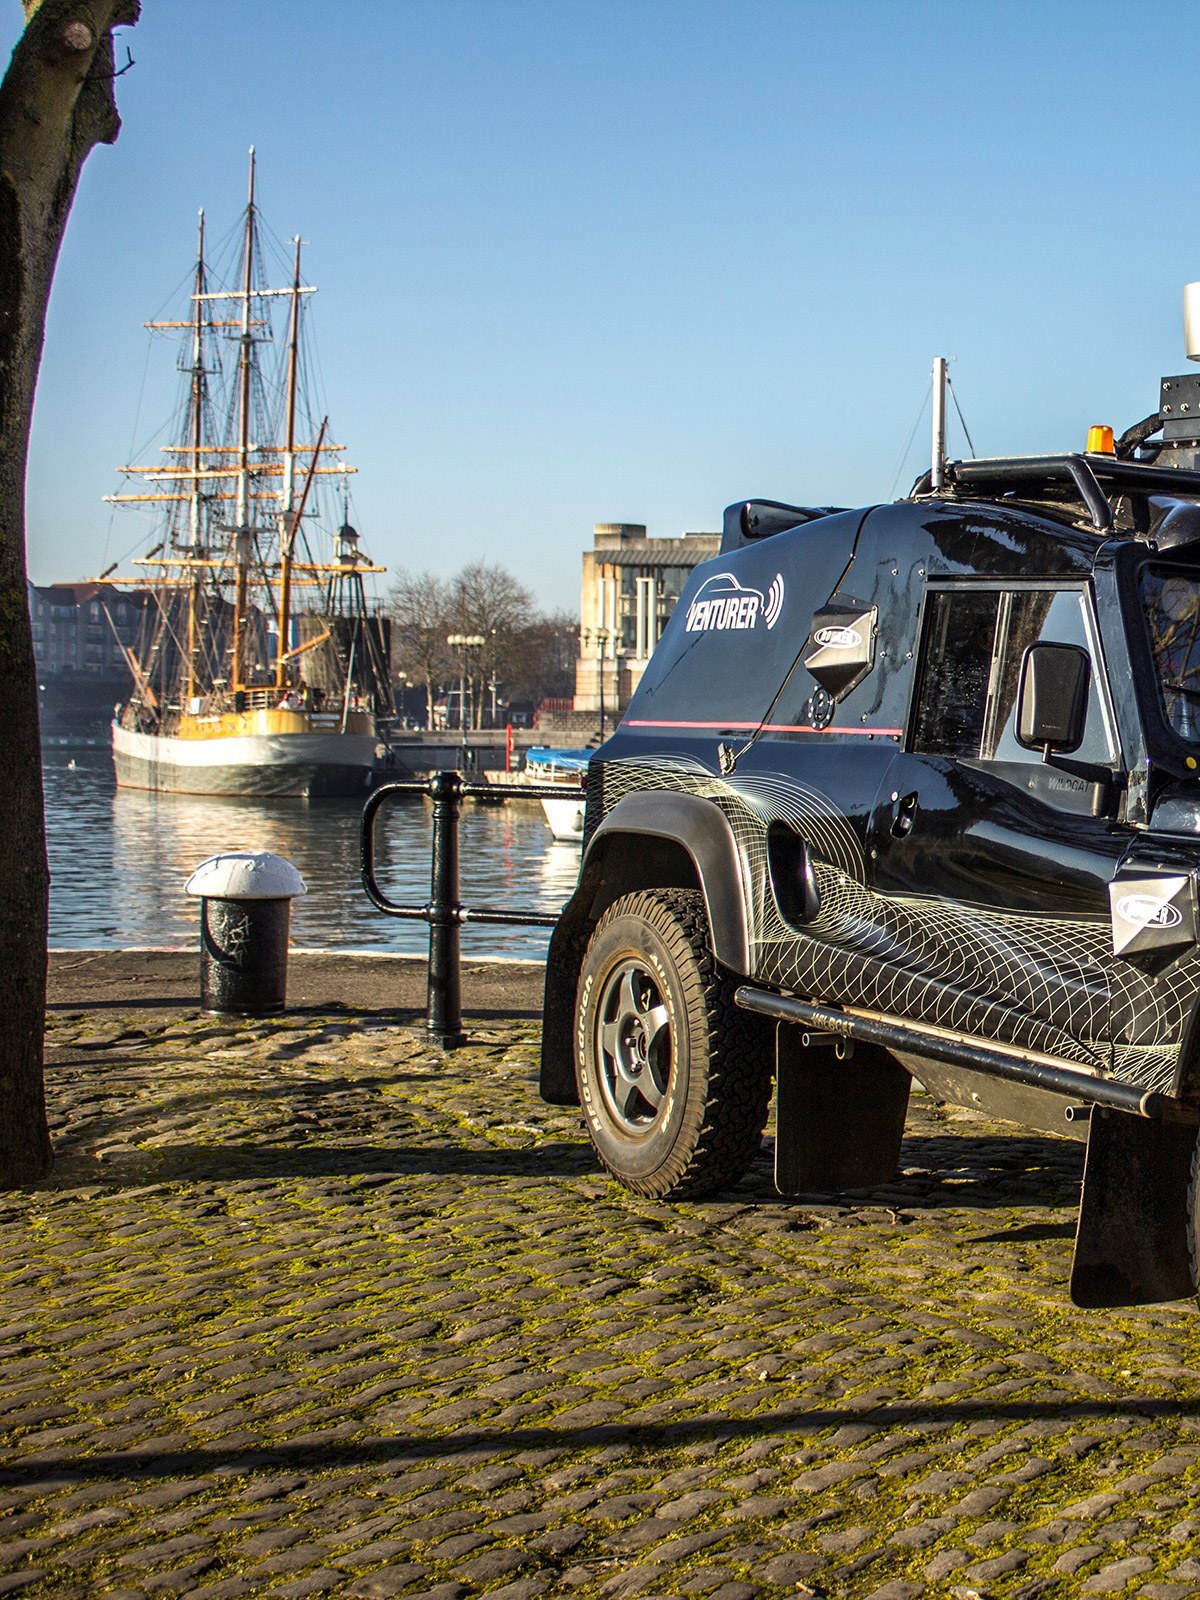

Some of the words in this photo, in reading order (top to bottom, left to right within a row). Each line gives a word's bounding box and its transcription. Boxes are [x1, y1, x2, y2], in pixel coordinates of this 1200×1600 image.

[685, 596, 759, 632] VENTURER
[1048, 777, 1089, 792] WILDCAT
[577, 974, 603, 1132] BFGoodrich
